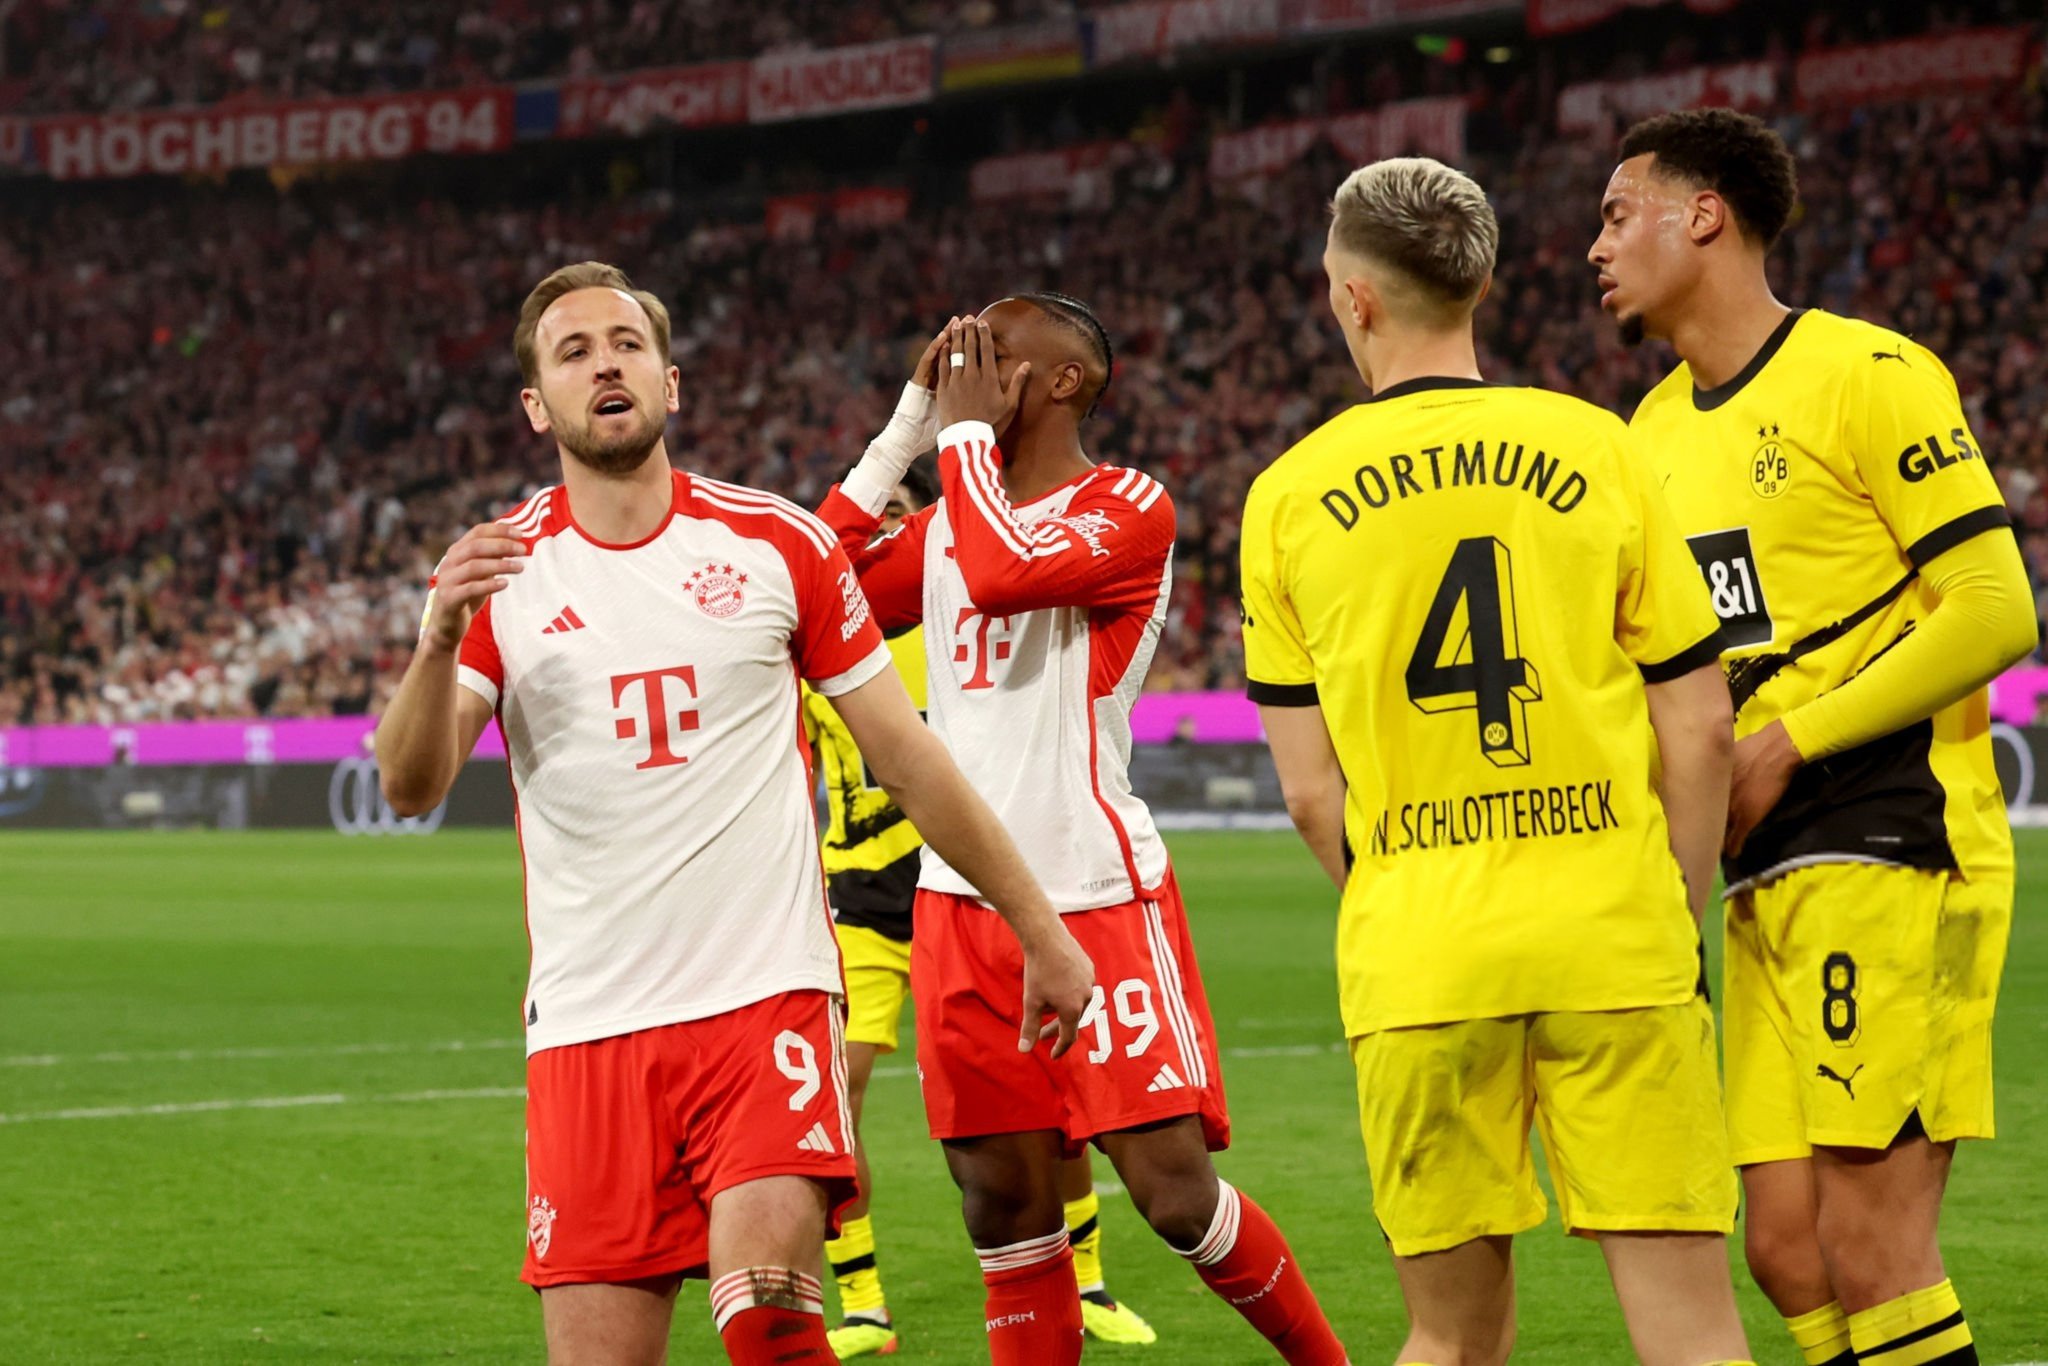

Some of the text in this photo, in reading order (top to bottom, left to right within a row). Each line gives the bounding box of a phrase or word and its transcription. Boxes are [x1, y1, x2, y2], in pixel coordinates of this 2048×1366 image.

[1320, 440, 1588, 532] DORTMUND
[1755, 446, 1788, 483] BVB
[1763, 481, 1777, 494] 09
[1697, 556, 1757, 618] &1
[1405, 536, 1542, 768] 4
[610, 664, 700, 770] T
[1371, 779, 1619, 857] N.SCHLOTTERBECK
[1077, 978, 1160, 1065] 39
[1821, 951, 1862, 1048] 8
[772, 1028, 821, 1112] 9
